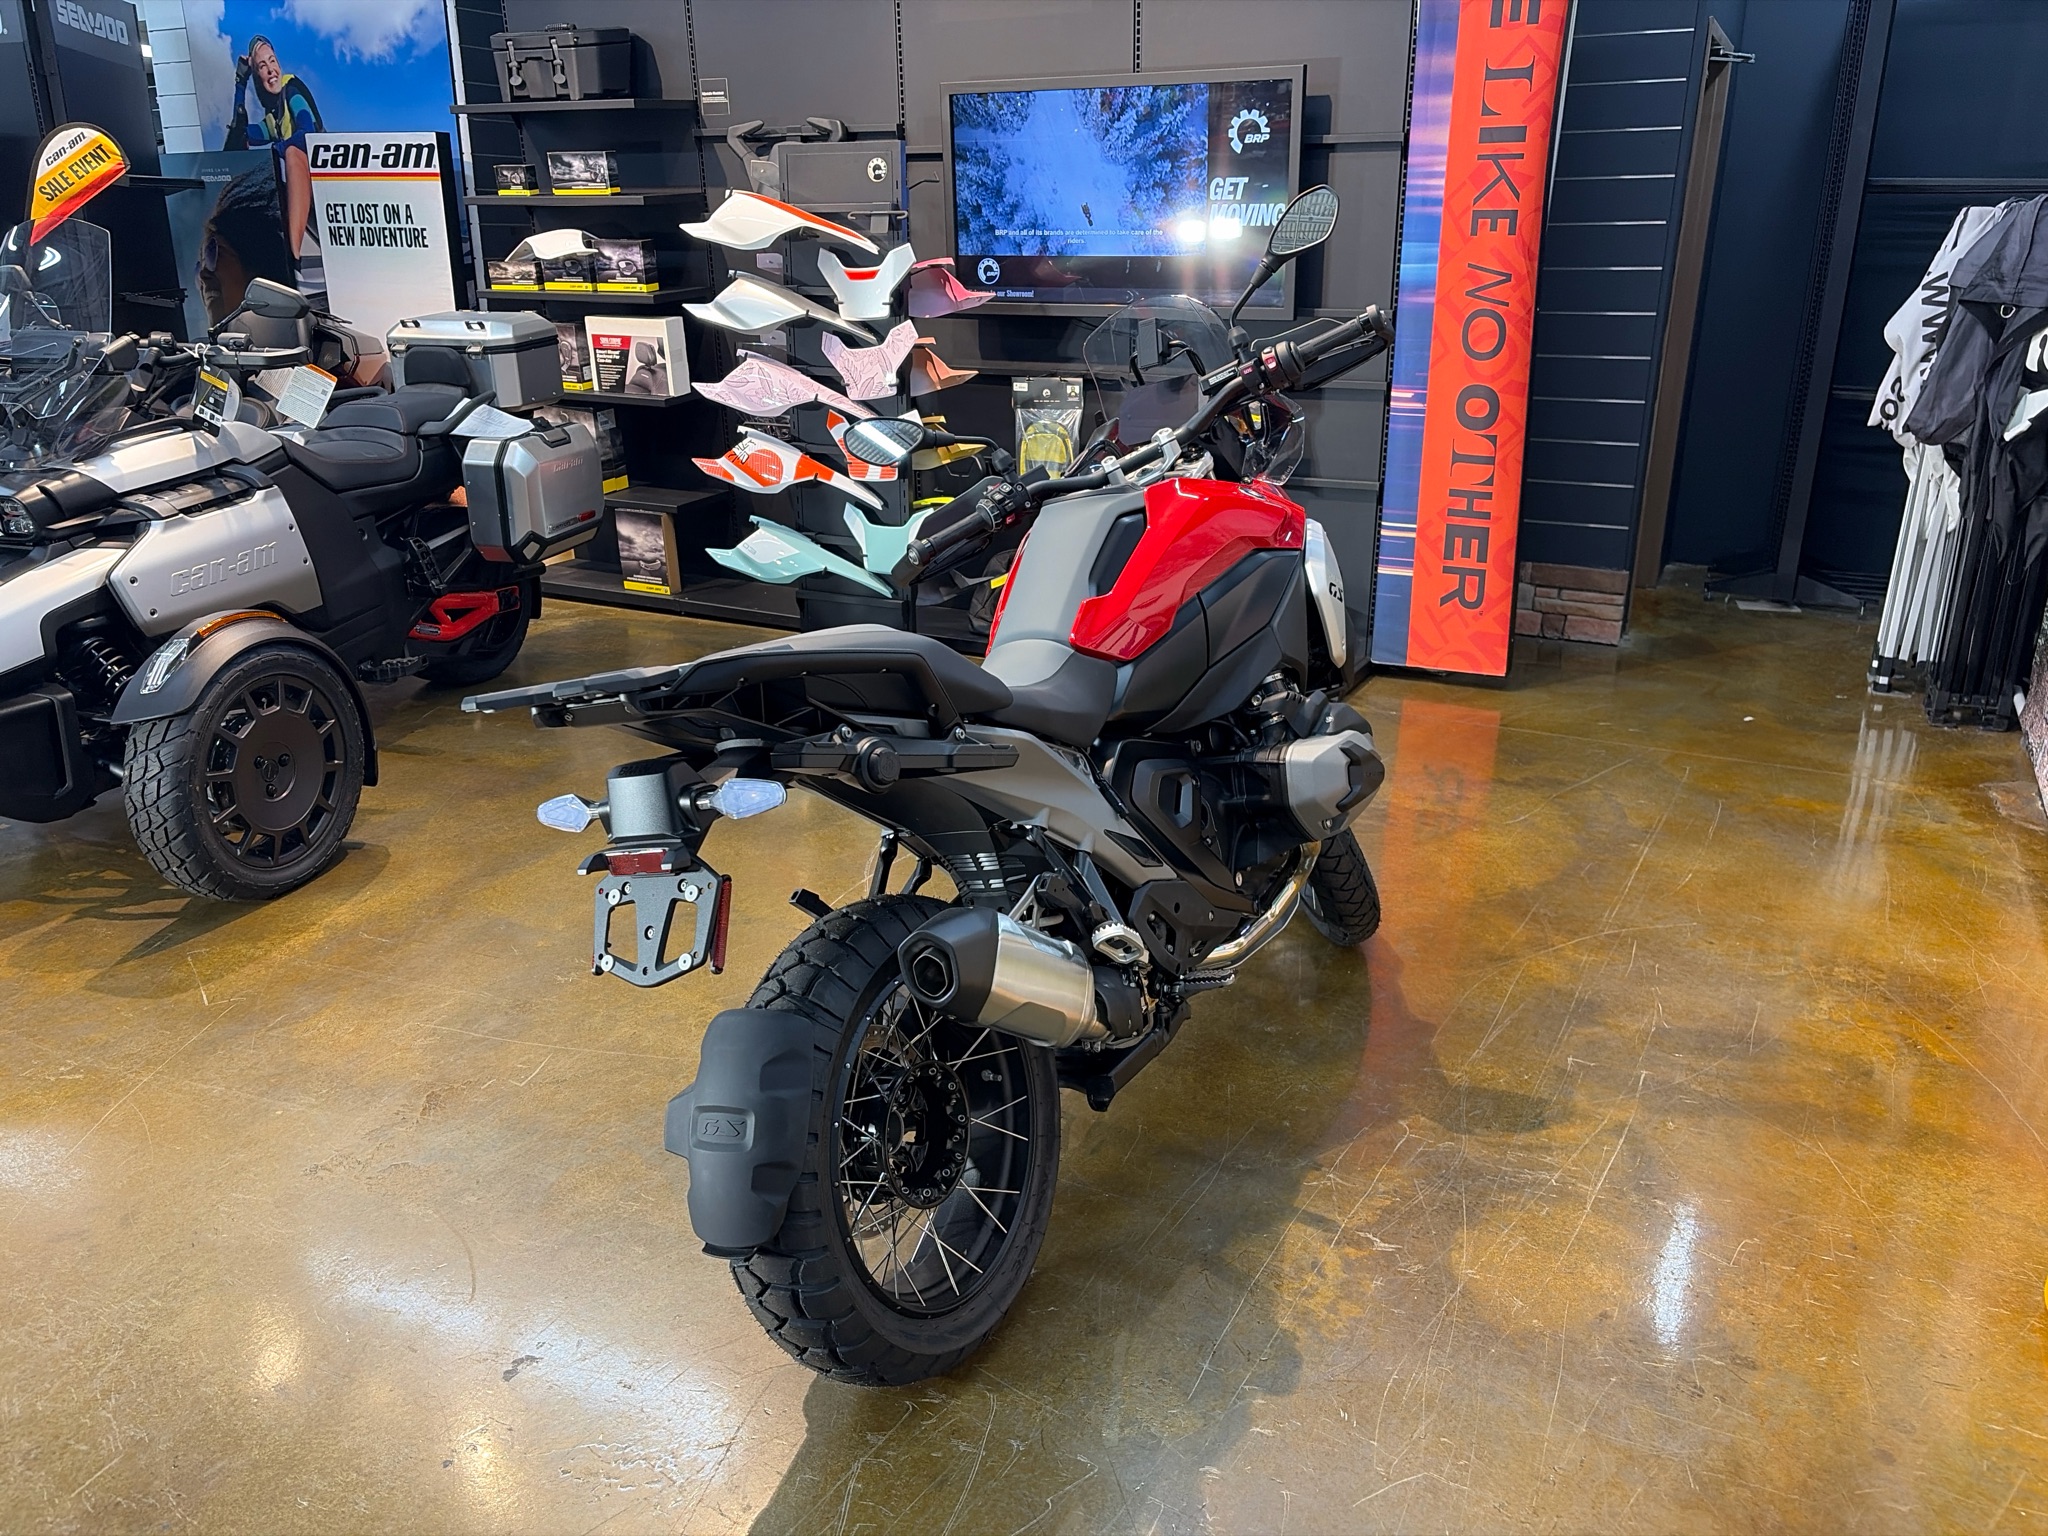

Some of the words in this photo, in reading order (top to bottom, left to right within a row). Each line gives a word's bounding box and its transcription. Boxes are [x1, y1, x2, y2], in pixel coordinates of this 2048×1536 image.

[45, 132, 87, 167] can-am
[1244, 133, 1270, 143] BRP
[1470, 55, 1535, 236] LIKE
[68, 143, 111, 181] EVENT
[310, 143, 436, 169] can-am
[38, 170, 75, 202] SALE
[1210, 177, 1249, 200] GET
[325, 203, 347, 224] GET
[350, 203, 379, 224] LOST
[383, 203, 402, 225] ON
[404, 204, 415, 225] A
[328, 226, 355, 247] NEW
[360, 227, 429, 249] ADVENTURE
[1461, 263, 1513, 362] NO
[1440, 383, 1500, 611] OTHER
[171, 541, 278, 597] can-am
[1329, 582, 1344, 603] GS
